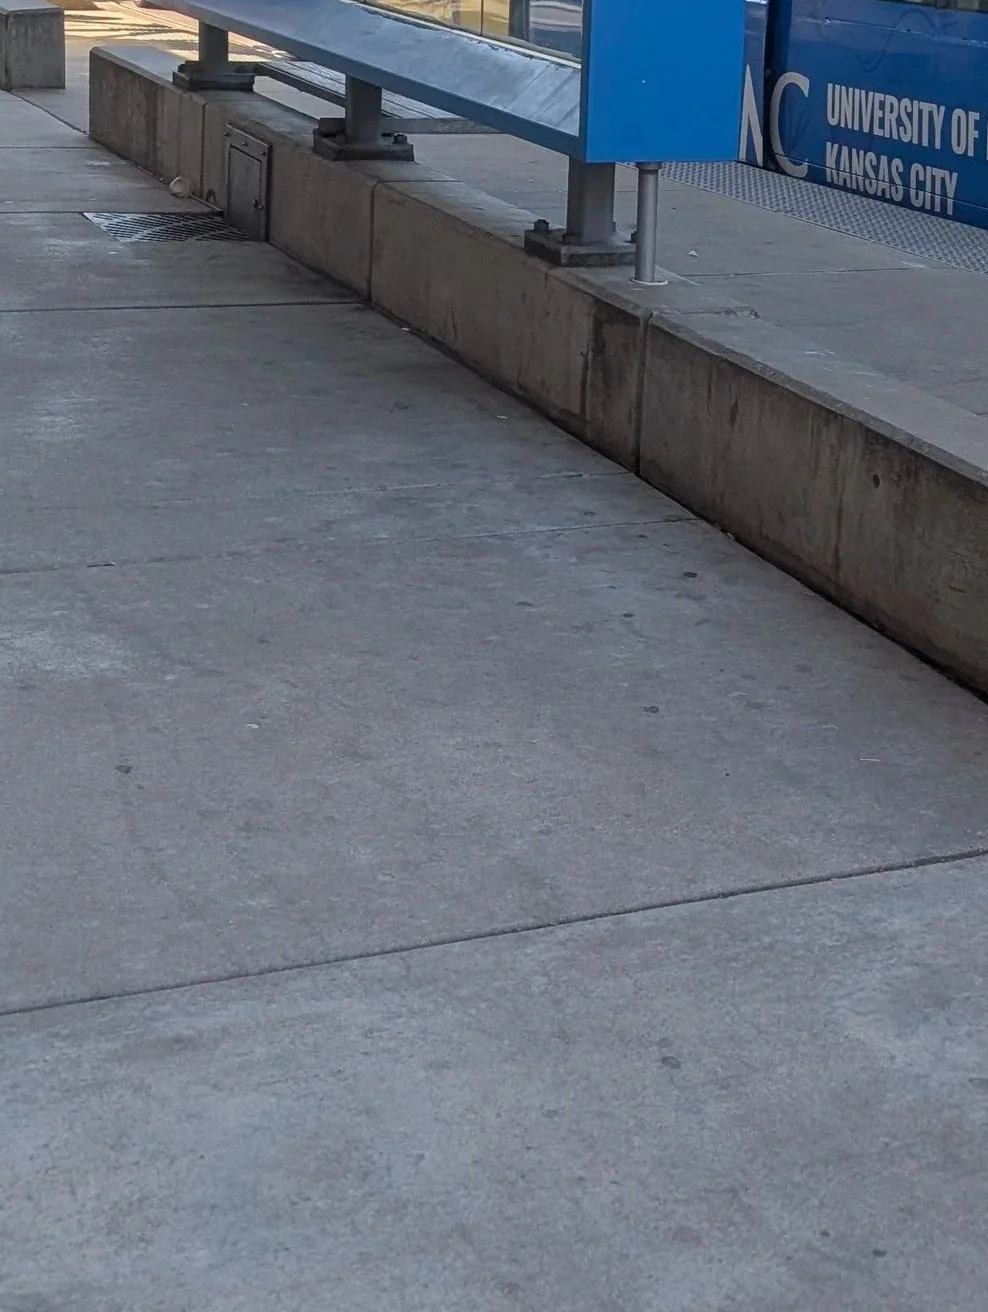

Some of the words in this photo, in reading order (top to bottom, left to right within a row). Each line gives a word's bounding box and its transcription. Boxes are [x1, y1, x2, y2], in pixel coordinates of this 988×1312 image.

[826, 82, 946, 150] UNIVERSITY
[951, 108, 980, 157] OF
[826, 141, 904, 202] KANSAS
[910, 163, 958, 216] CITY
